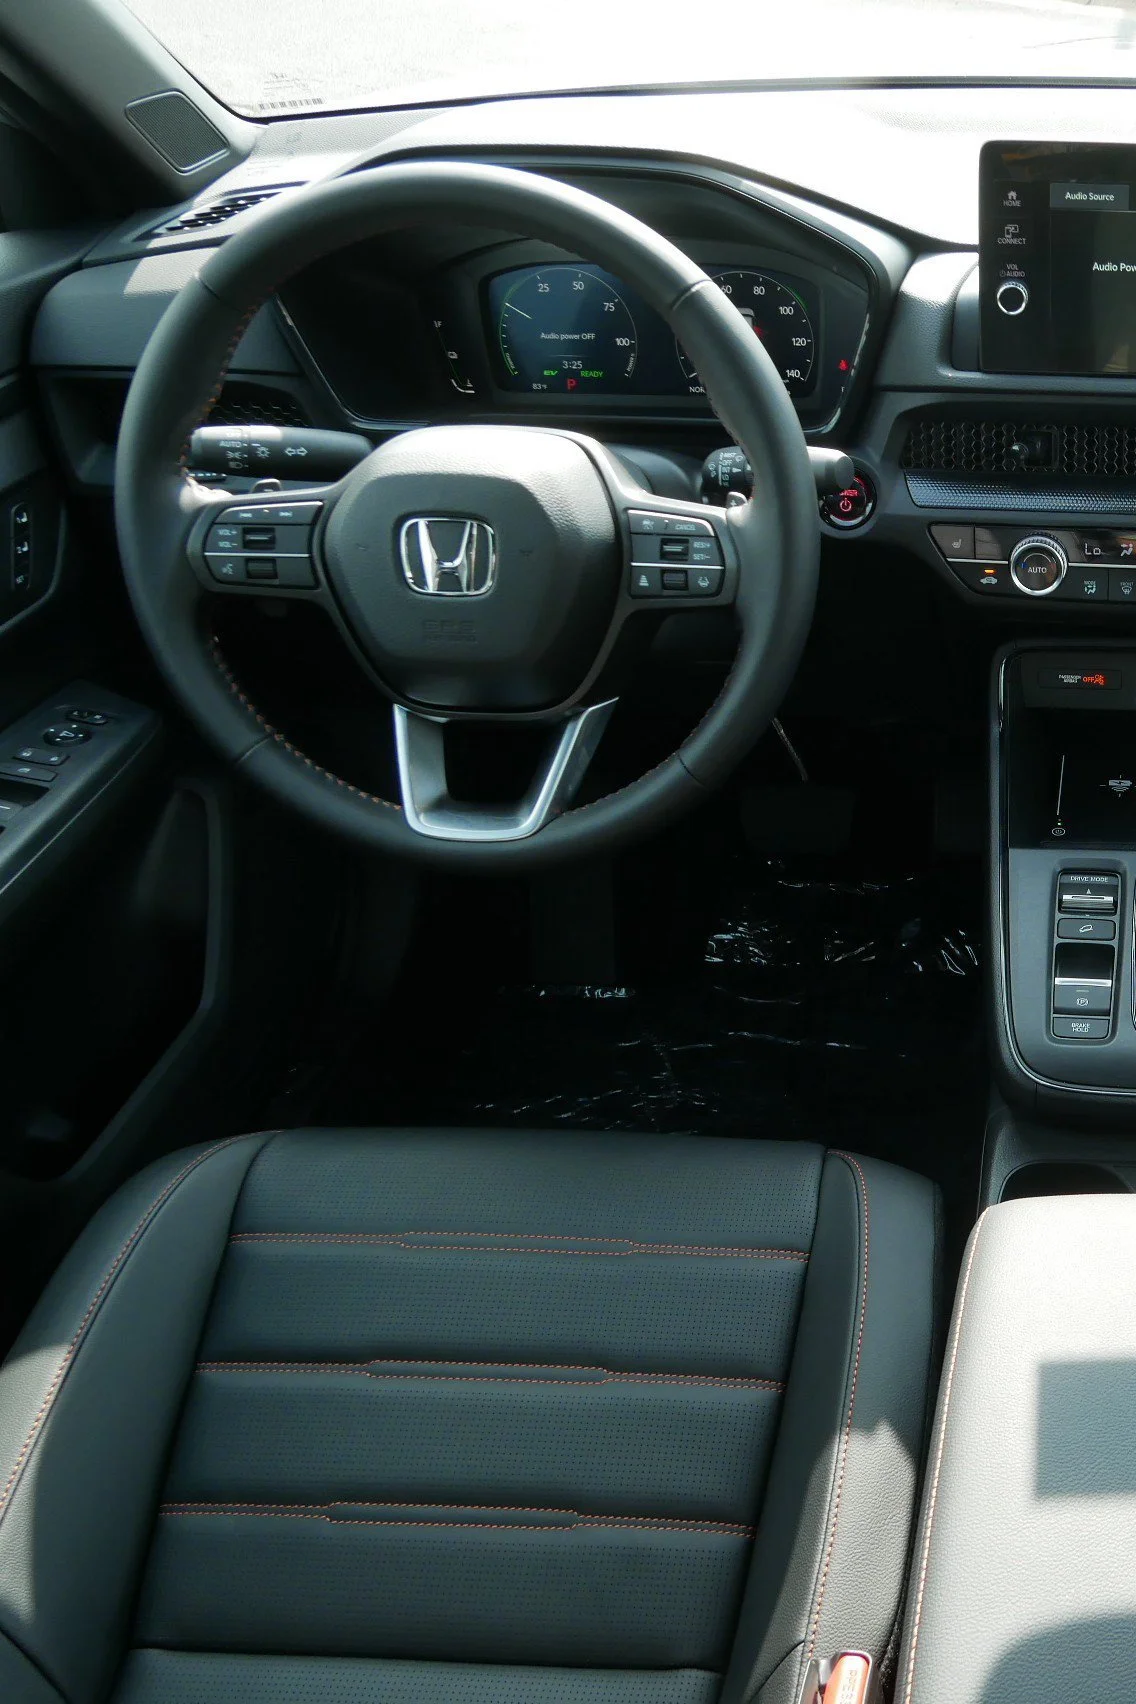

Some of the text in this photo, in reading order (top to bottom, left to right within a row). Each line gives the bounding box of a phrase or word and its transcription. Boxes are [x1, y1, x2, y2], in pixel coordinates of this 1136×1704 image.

[1065, 191, 1115, 201] Audio Source
[1092, 262, 1118, 272] Audio
[538, 283, 550, 293] 25
[572, 281, 584, 291] 50
[753, 286, 765, 296] 80
[603, 302, 615, 311] 75
[779, 306, 794, 315] 100
[540, 332, 596, 341] Audio power OFF
[615, 337, 630, 346] 100
[791, 337, 807, 346] 120
[562, 360, 583, 369] 3:25
[785, 369, 801, 378] 140
[567, 379, 577, 390] P
